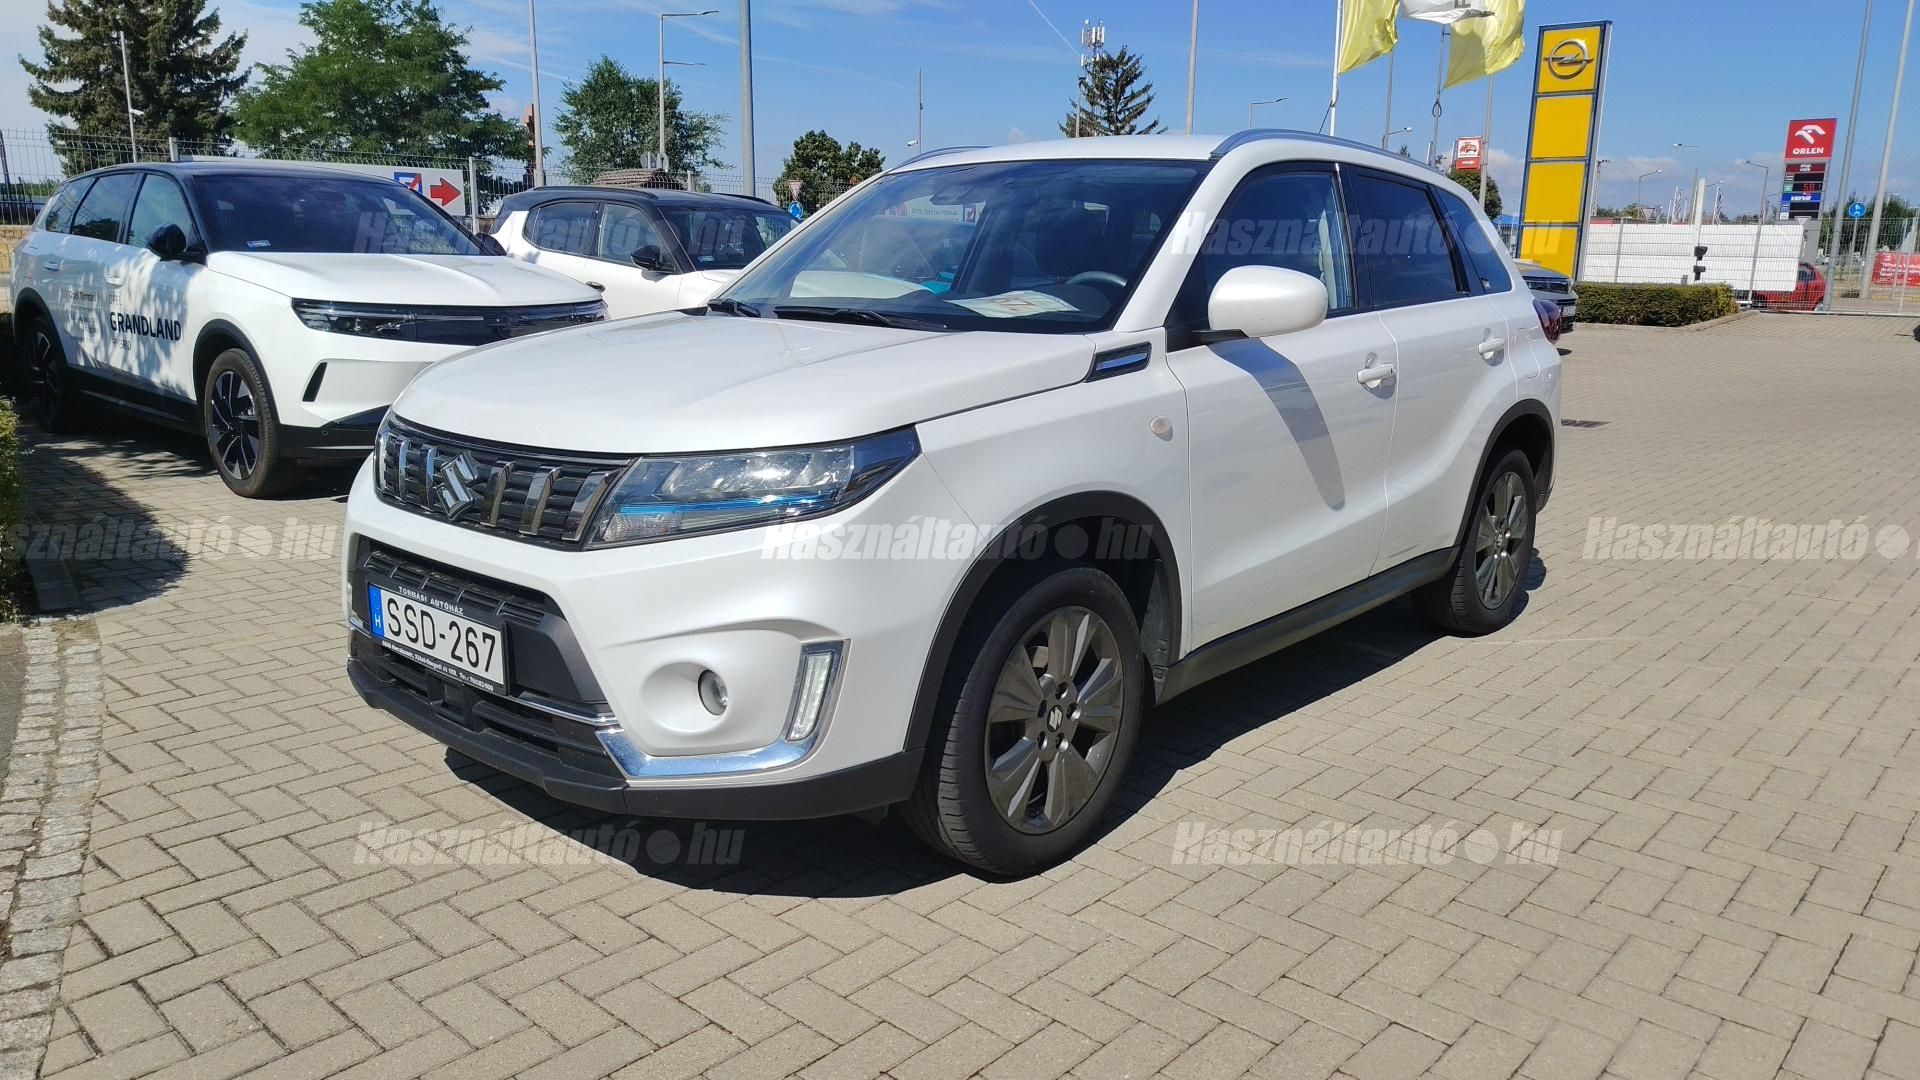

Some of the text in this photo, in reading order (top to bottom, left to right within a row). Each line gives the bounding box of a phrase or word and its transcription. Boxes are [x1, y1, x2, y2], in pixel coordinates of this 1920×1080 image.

[1792, 147, 1825, 155] ORLEN
[109, 312, 182, 341] GRANDLAND
[387, 597, 496, 673] SSD-267
